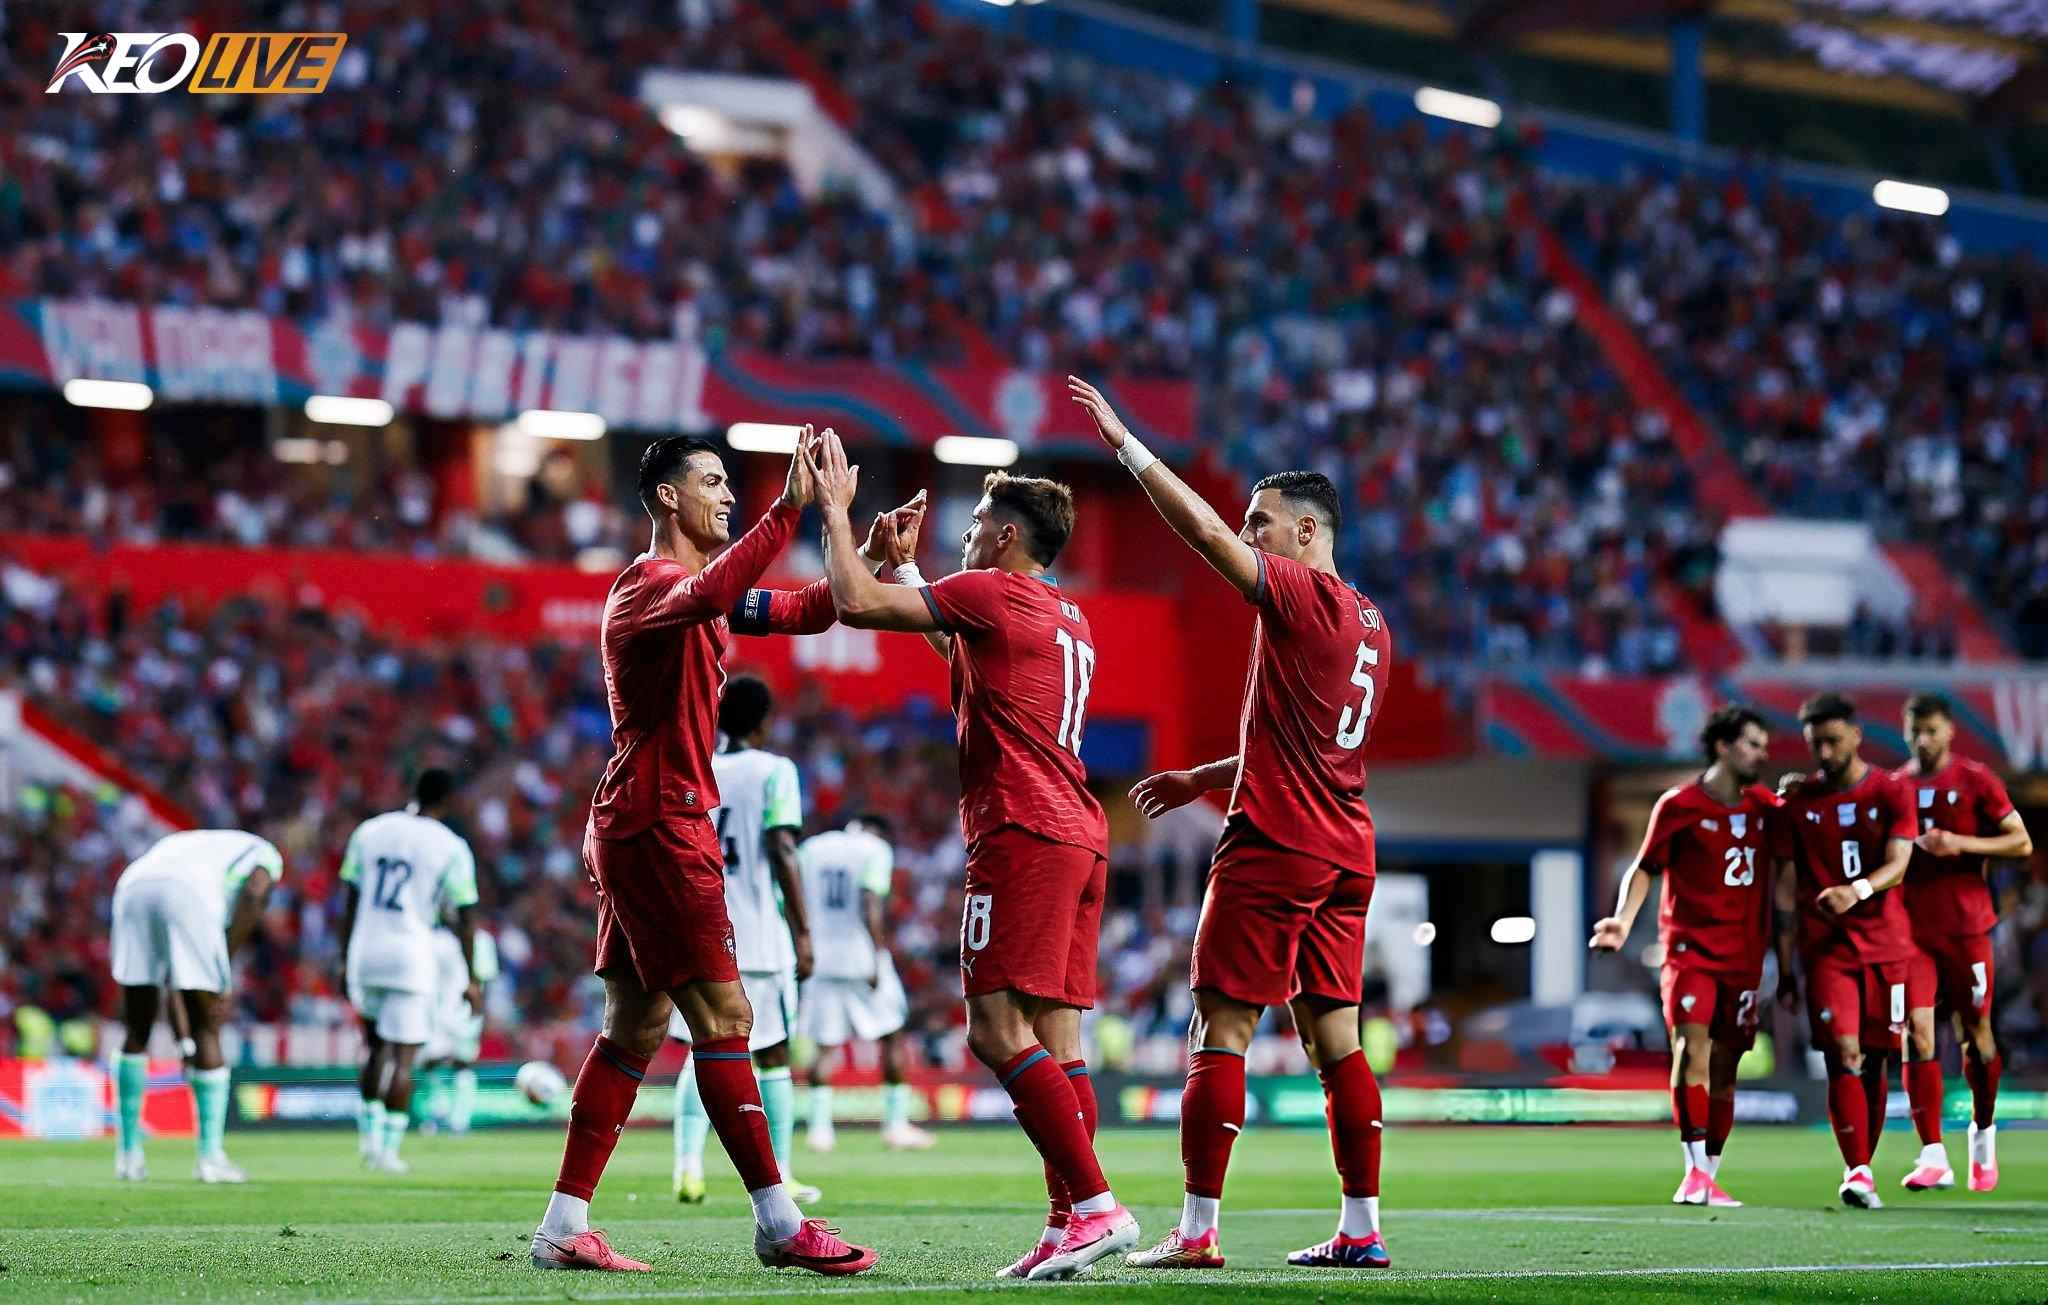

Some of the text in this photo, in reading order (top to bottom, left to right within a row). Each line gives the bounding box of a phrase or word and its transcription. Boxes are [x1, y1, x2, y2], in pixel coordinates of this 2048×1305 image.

[1055, 627, 1095, 759] 18
[1336, 640, 1379, 750] 5
[373, 857, 413, 913] 12
